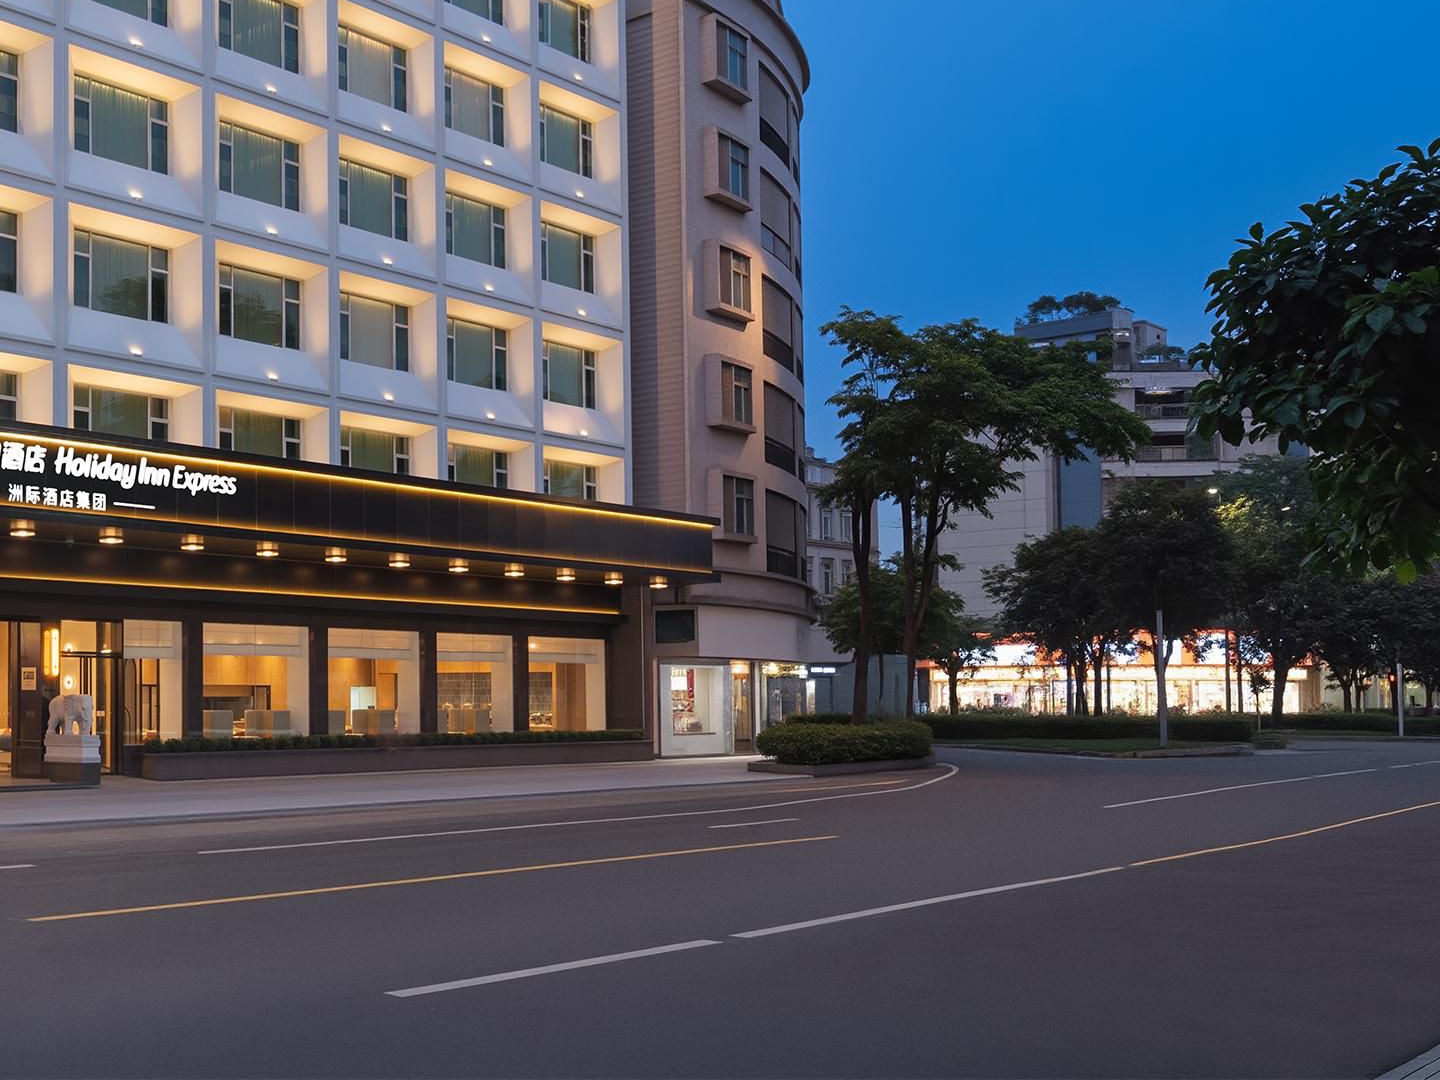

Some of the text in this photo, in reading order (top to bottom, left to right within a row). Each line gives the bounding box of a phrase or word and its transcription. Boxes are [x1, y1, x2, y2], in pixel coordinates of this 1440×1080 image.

[54, 446, 137, 489] Holiday
[138, 457, 171, 487] Inn
[172, 465, 238, 496] Express
[8, 483, 107, 511] 洲际酒店集团
